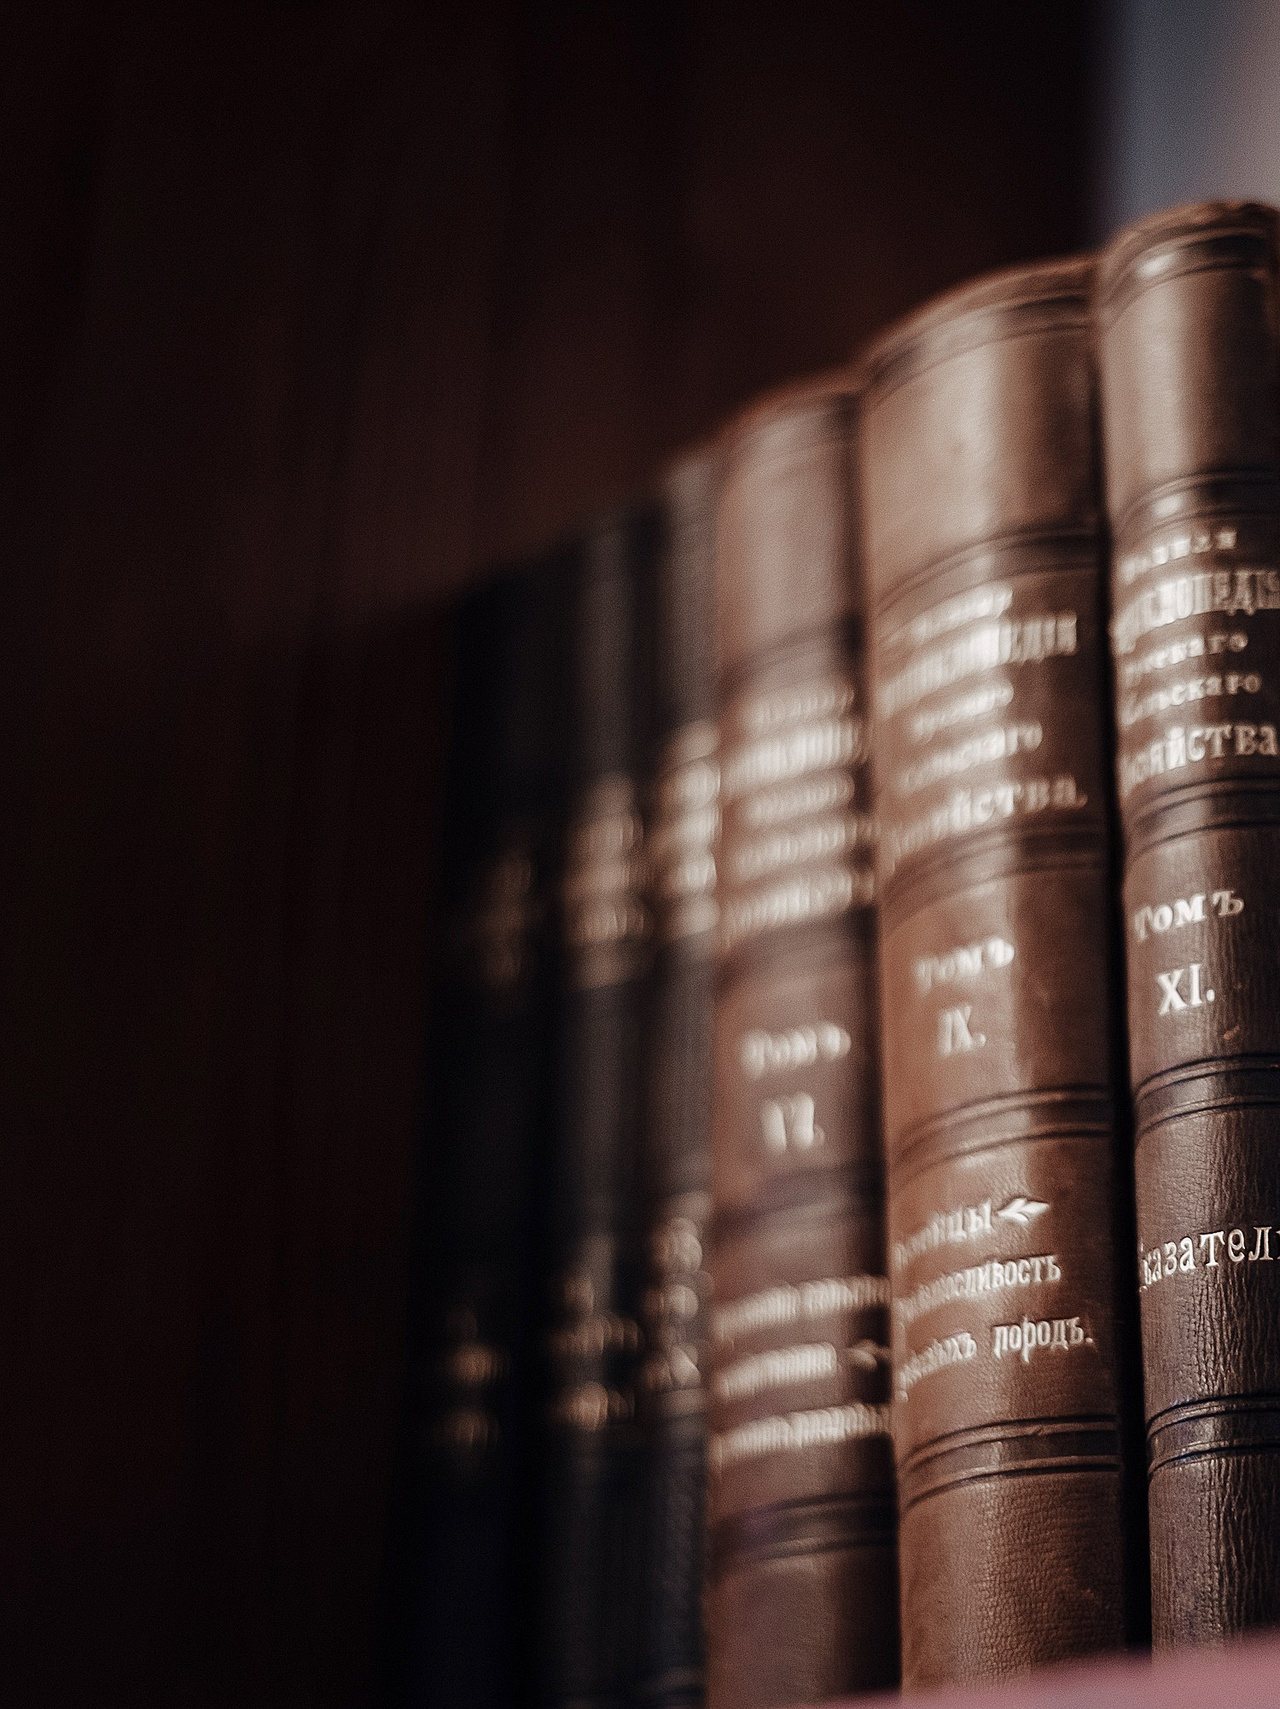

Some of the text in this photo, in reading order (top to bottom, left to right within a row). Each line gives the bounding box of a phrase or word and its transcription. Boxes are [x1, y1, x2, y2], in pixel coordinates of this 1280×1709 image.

[1132, 890, 1245, 943] Томъ
[1157, 963, 1216, 1015] XI.
[991, 1317, 1095, 1365] породъ.
